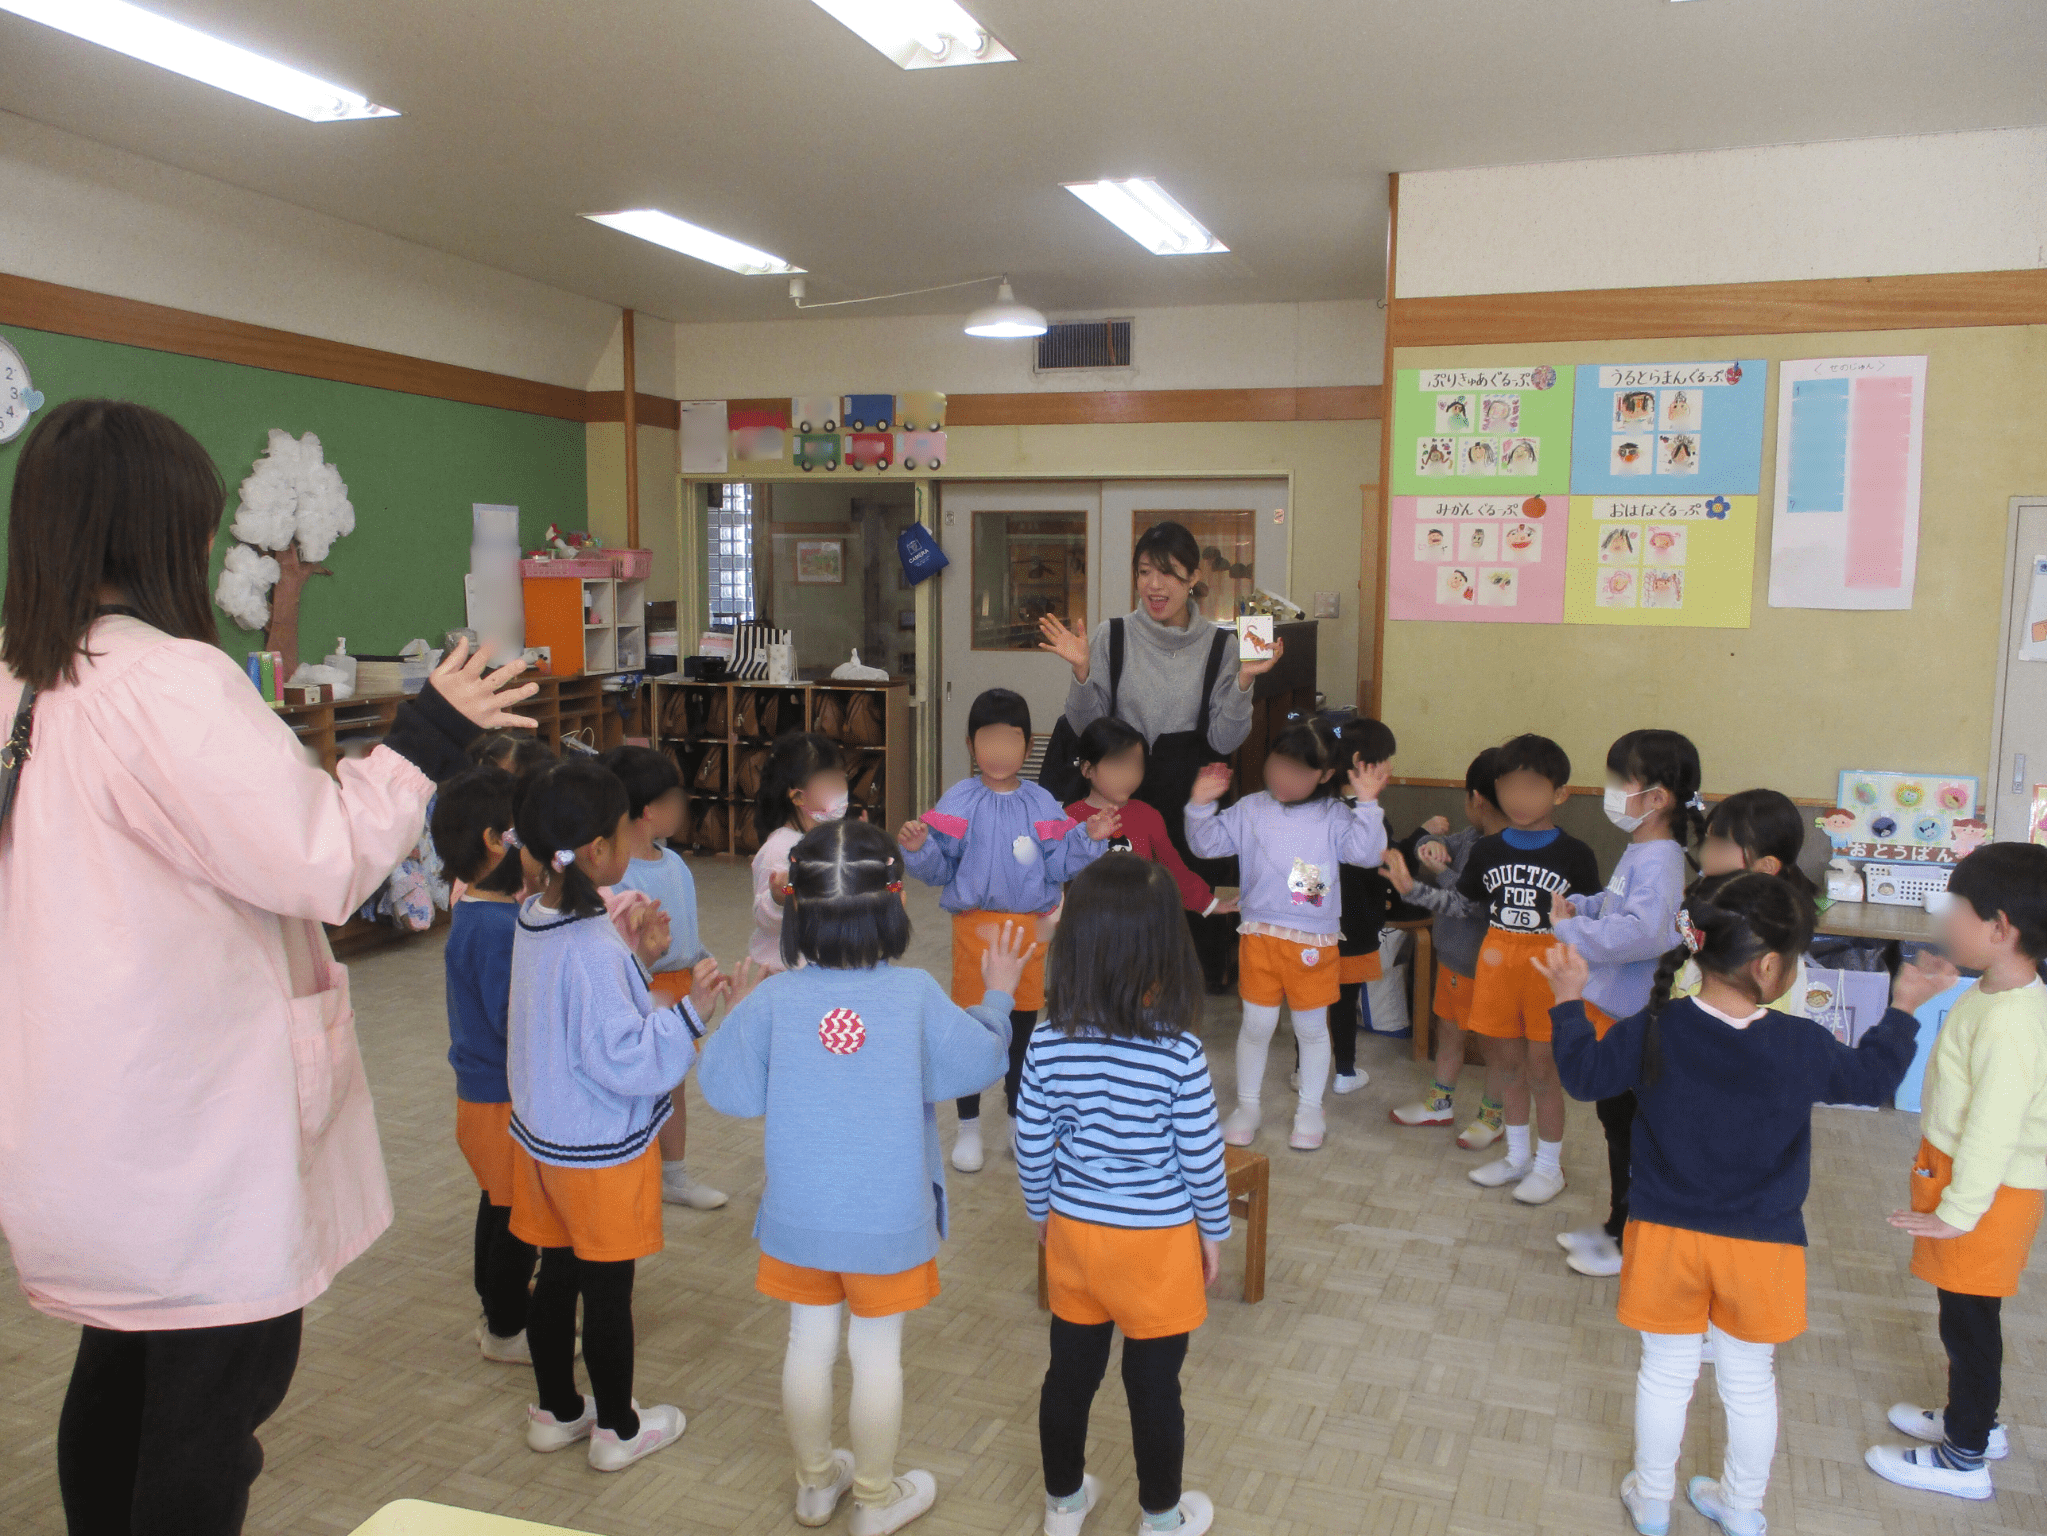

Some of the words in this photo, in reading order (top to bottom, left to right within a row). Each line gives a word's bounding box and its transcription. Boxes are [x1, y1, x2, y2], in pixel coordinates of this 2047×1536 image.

[6, 367, 13, 380] 2
[10, 387, 18, 400] 3
[6, 406, 14, 419] 4
[1610, 502, 1701, 518] おはなぐるーぷ
[908, 548, 930, 564] CAMERA
[1848, 843, 1953, 863] おとうばん
[1504, 886, 1537, 907] FOR
